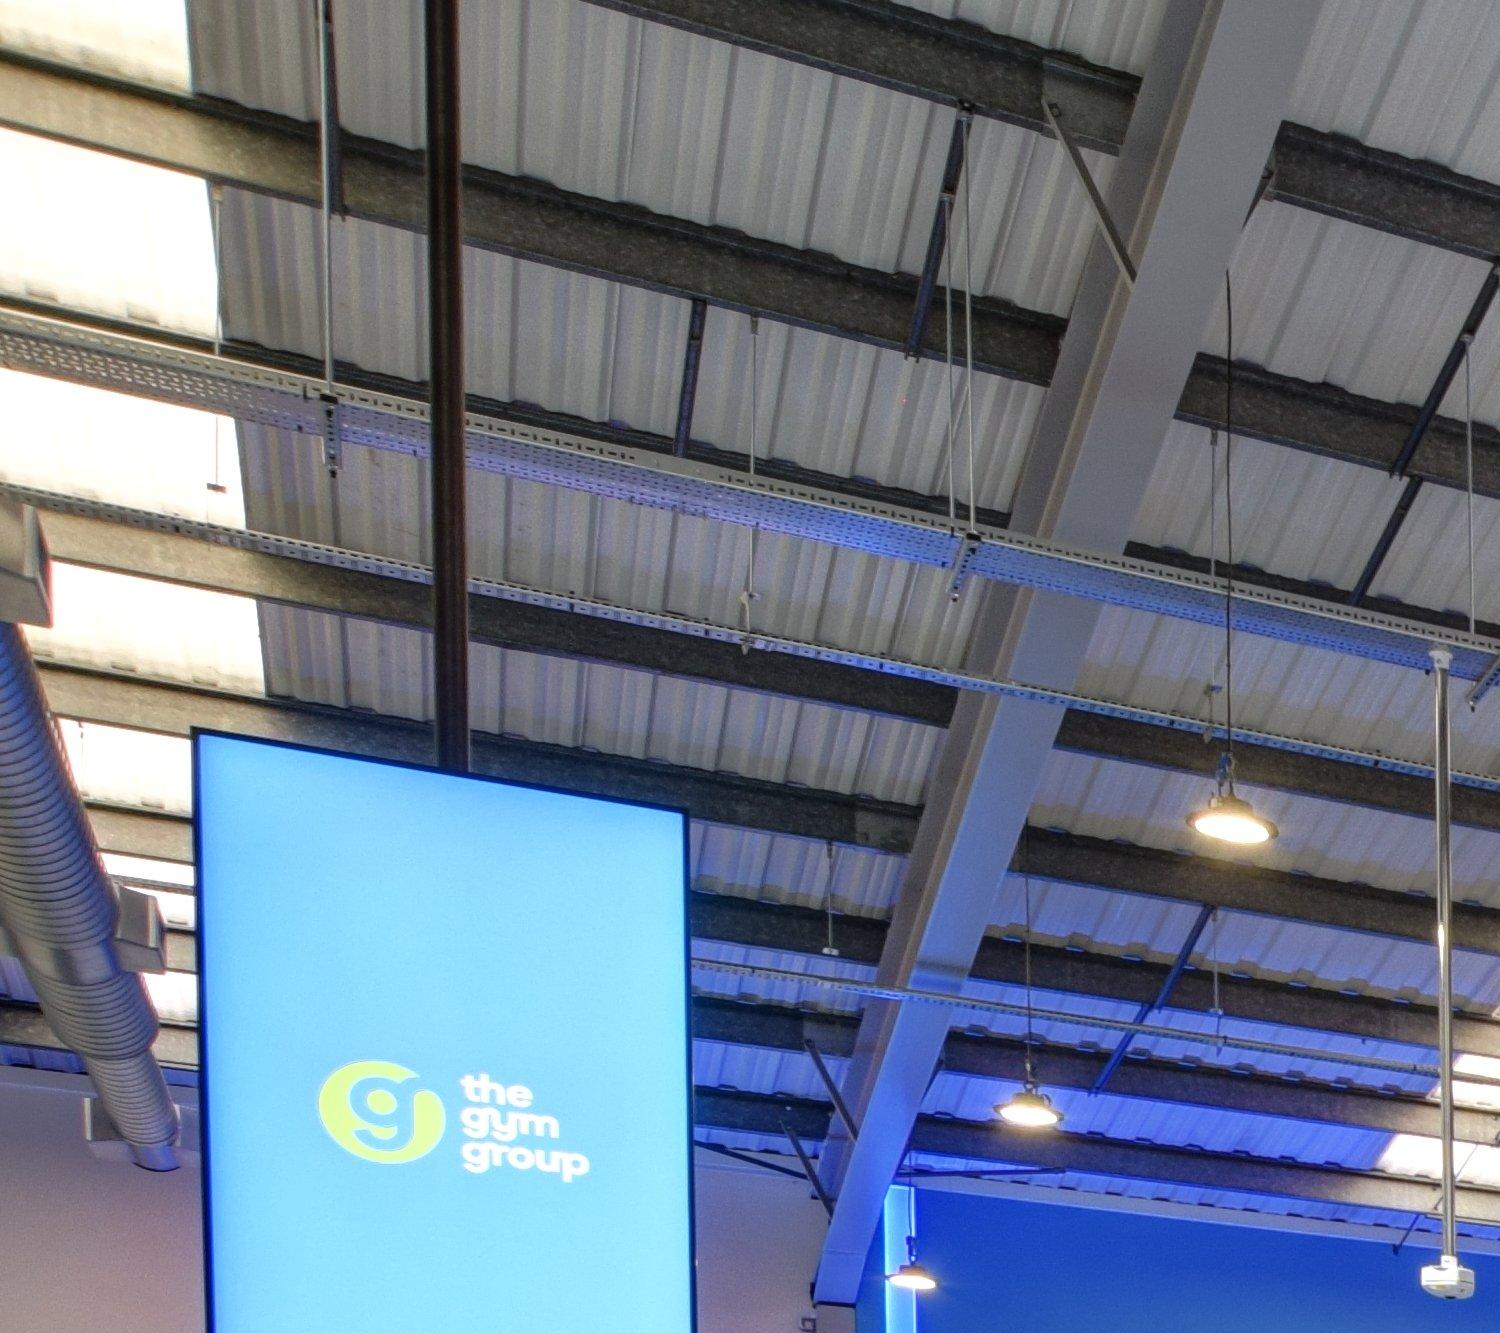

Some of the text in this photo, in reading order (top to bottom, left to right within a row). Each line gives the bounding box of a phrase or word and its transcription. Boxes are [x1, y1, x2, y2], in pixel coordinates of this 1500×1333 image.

[460, 1073, 533, 1108] the
[460, 1106, 560, 1142] gym
[460, 1141, 591, 1183] group
